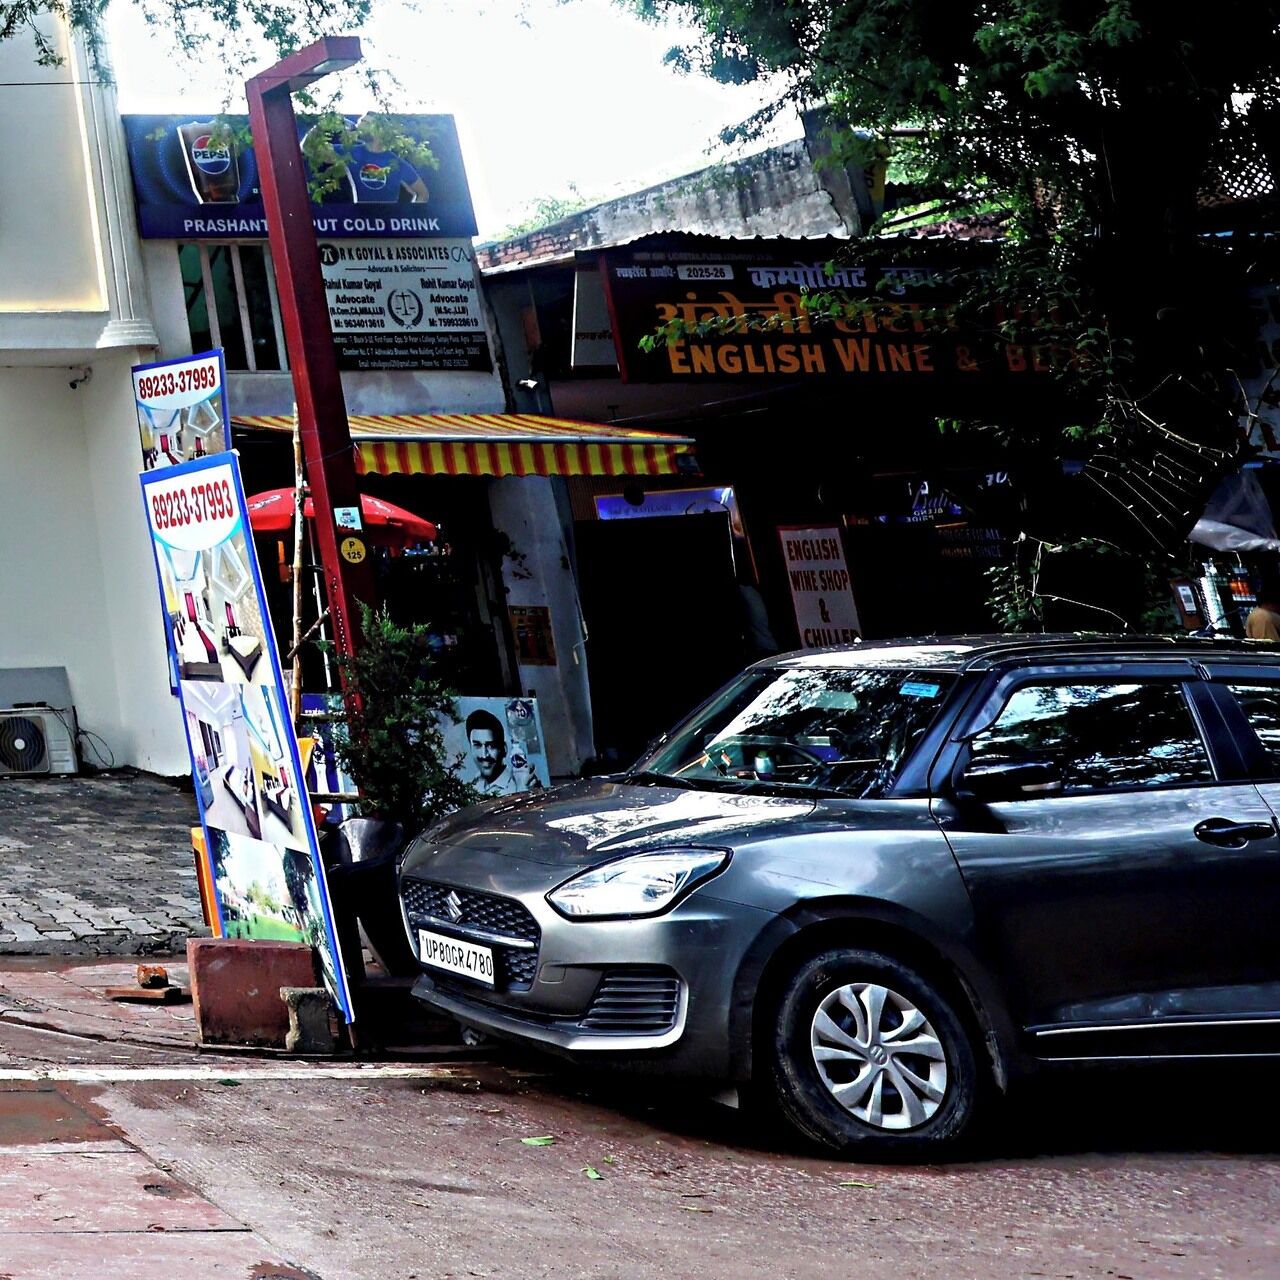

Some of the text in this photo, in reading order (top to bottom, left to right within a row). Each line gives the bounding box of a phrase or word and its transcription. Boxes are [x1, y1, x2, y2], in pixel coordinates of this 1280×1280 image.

[193, 150, 230, 160] PEPSI
[184, 219, 268, 232] PRASHANT
[344, 219, 386, 231] COLD
[391, 218, 440, 231] DRINK
[340, 247, 346, 260] R
[348, 247, 355, 260] K
[356, 247, 385, 260] GOYAL
[396, 246, 449, 260] ASSOCIATES
[686, 267, 725, 278] 2025-26
[342, 279, 363, 289] Kumar
[364, 279, 382, 292] Goyal
[420, 278, 475, 291] Rohit Kumar Goyal
[336, 294, 375, 304] Advocate
[430, 293, 468, 303] Advocate
[667, 338, 827, 375] ENGLISH
[831, 337, 935, 373] WINE
[787, 538, 839, 560] ENGLISH
[790, 570, 848, 591] WINE SHOP
[818, 598, 831, 623] &
